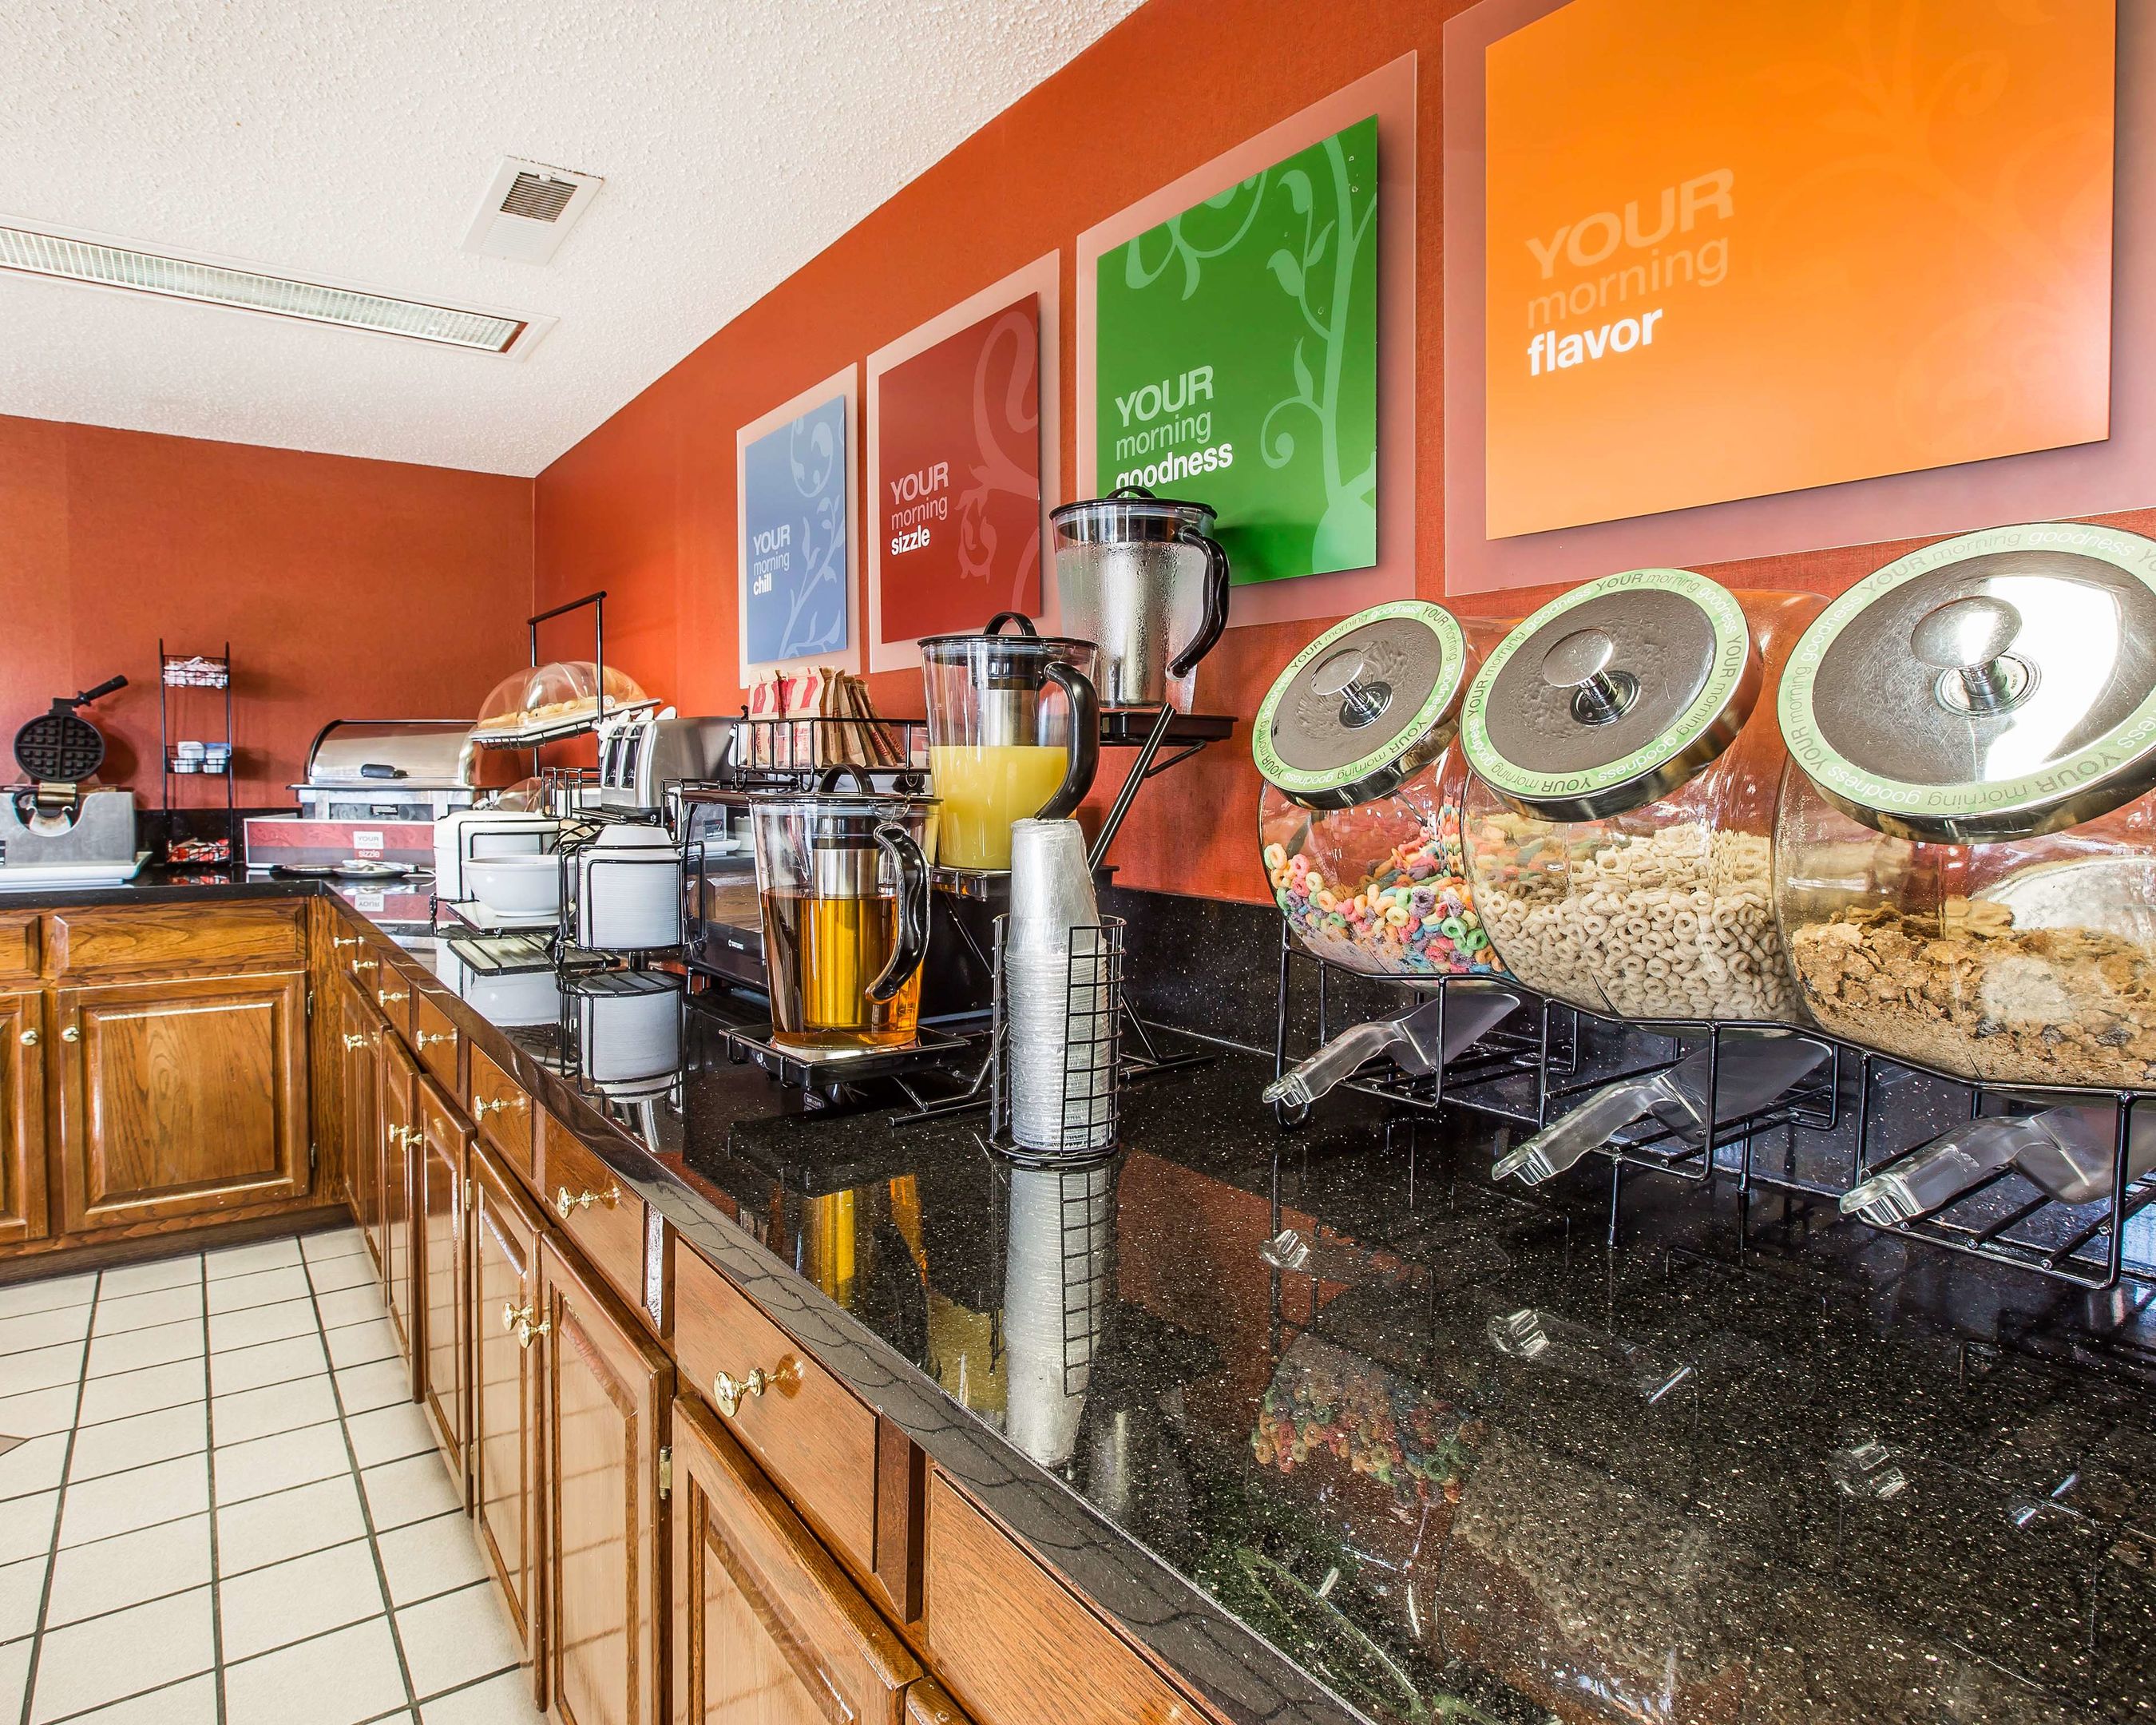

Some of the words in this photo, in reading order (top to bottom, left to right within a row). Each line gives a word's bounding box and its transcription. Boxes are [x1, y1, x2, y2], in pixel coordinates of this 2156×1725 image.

[1524, 168, 1734, 280] YOUR
[1528, 237, 1728, 329] morning
[1527, 307, 1663, 376] flavor
[1115, 365, 1214, 427] YOUR
[1116, 412, 1211, 461] morning
[890, 462, 949, 505] YOUR
[1116, 443, 1233, 498] goodness
[892, 496, 947, 530] morning
[753, 524, 790, 555] YOUR
[891, 525, 930, 555] sizzle
[754, 551, 790, 576] morning
[1861, 557, 1927, 593] YOUR
[1932, 530, 2021, 560] morning
[2028, 530, 2135, 557] goodness
[753, 573, 771, 595] chill
[1596, 573, 1643, 591] YOUR
[1647, 574, 1702, 593] morning
[1698, 588, 1737, 634] goodness
[1290, 640, 1322, 669] YOUR
[1325, 614, 1368, 641] morning
[1371, 605, 1421, 619] goodness
[1422, 605, 1449, 627] YOUR
[1801, 595, 1863, 661] goodness
[1445, 625, 1457, 661] morning
[1467, 680, 1488, 718] YOUR
[1484, 632, 1525, 676] morning
[1526, 589, 1591, 631] goodness
[1719, 636, 1742, 677] YOUR
[1262, 672, 1292, 719] goodness
[1425, 664, 1456, 717] goodness
[1677, 683, 1726, 736] morning
[1787, 666, 1812, 724] morning
[1258, 720, 1270, 755] morning
[1389, 720, 1427, 754] YOUR
[1469, 719, 1496, 766] goodness
[1791, 726, 1829, 771] YOUR
[1262, 755, 1284, 779] YOUR
[1284, 771, 1334, 787] goodness
[1338, 751, 1386, 779] morning
[1492, 762, 1539, 791] morning
[1599, 736, 1678, 782] goodness
[2035, 751, 2121, 792] YOUR
[1542, 777, 1591, 792] YOUR
[1828, 764, 1921, 806] goodness
[1928, 783, 2028, 807] morning
